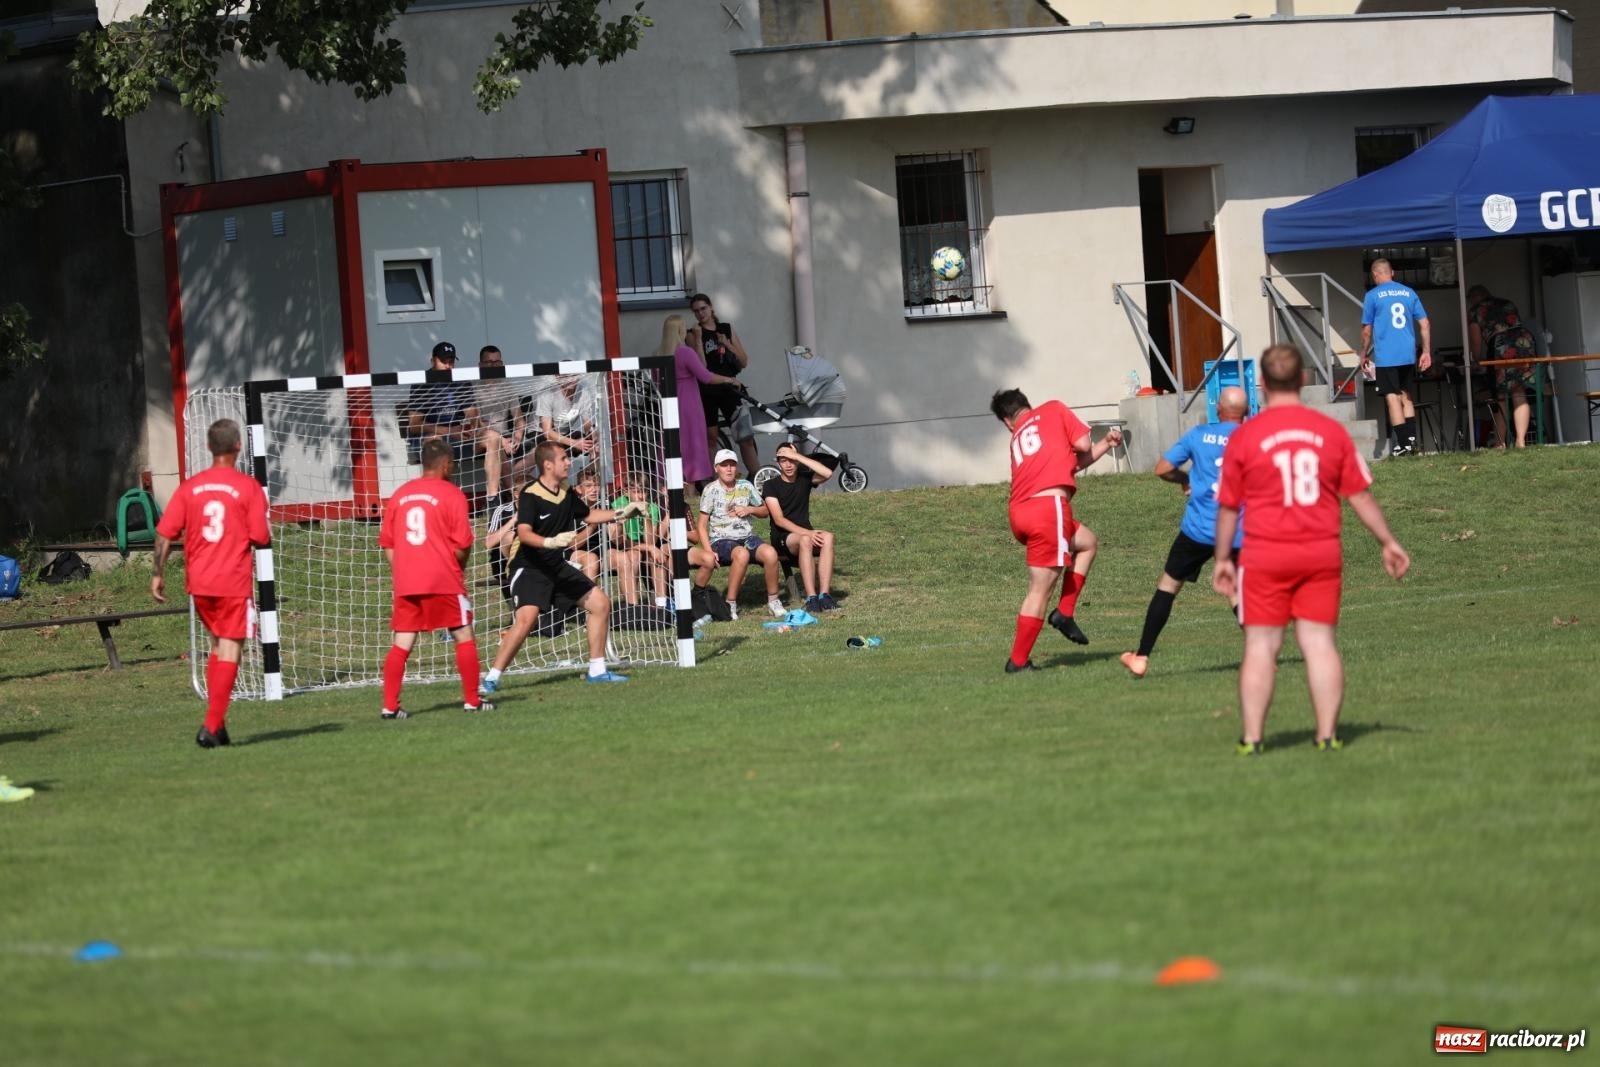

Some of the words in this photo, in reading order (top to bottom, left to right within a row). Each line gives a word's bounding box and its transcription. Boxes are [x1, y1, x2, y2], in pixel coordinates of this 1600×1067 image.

[1391, 302, 1406, 329] 8
[1013, 424, 1042, 468] 16
[1202, 433, 1217, 445] LKS
[1272, 448, 1321, 507] 18
[202, 500, 225, 543] 3
[406, 506, 427, 546] 9
